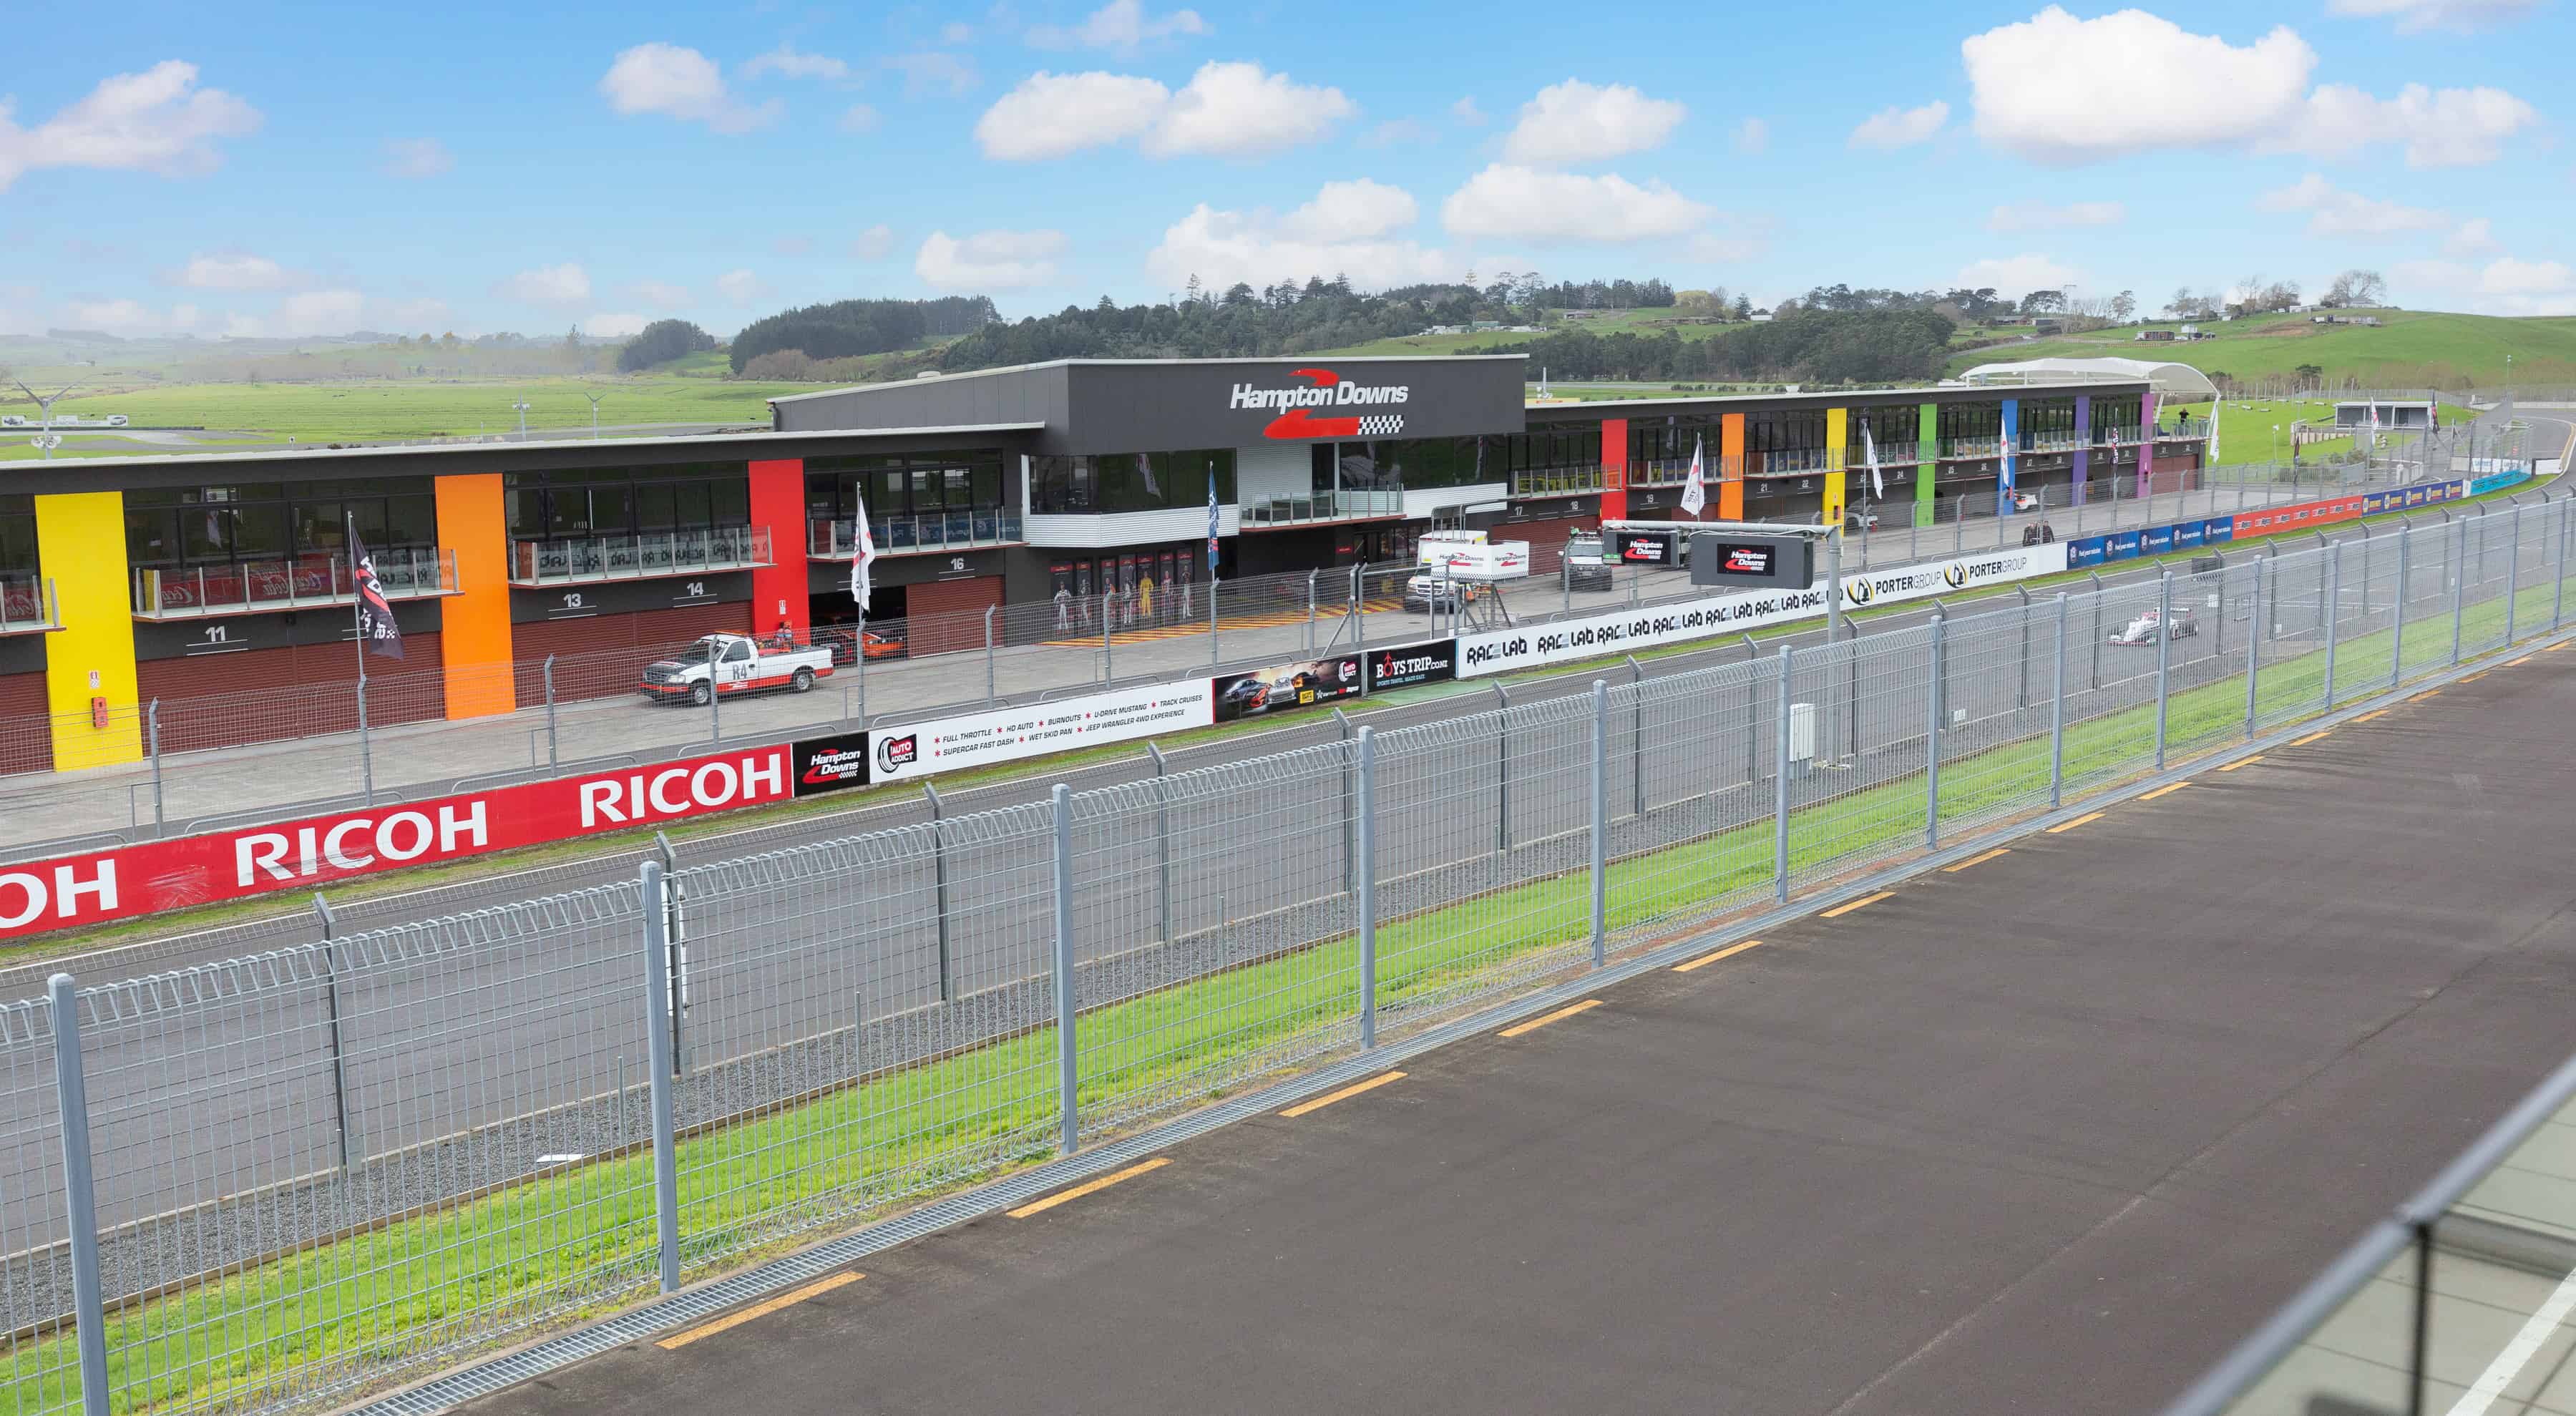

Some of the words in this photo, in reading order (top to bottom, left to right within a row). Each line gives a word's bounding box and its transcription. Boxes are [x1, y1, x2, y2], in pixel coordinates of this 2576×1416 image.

[1230, 383, 1333, 414] Hampton
[1336, 381, 1408, 405] Downs
[1760, 483, 1768, 492] 21
[1802, 479, 1809, 488] 22
[1570, 501, 1579, 510] 18
[1646, 494, 1654, 504] 19
[1515, 506, 1523, 516] 17
[1630, 540, 1663, 550] Hampton
[1636, 547, 1662, 555] Downs
[1731, 550, 1767, 561] Hampton
[1737, 558, 1765, 567] Downs
[950, 557, 965, 570] 16
[687, 582, 704, 596] 14
[563, 594, 581, 608] 13
[205, 625, 225, 642] 11
[732, 663, 747, 680] R4
[1376, 659, 1405, 678] BOYS
[943, 734, 958, 743] FULL
[960, 728, 992, 740] THROTTLE
[1017, 721, 1033, 731] AUTO
[1048, 714, 1081, 726] BURNOUTS
[1094, 708, 1117, 718] U-DRIVE
[1118, 703, 1147, 716] MUSTANG
[1160, 698, 1177, 708] TRACK
[1179, 695, 1202, 705] CRUISES
[943, 744, 978, 756] SUPERCAR
[980, 741, 995, 751] FAST
[997, 738, 1014, 748] DASH
[1044, 731, 1058, 739] SKID
[1059, 728, 1073, 736] PAN
[1085, 723, 1100, 732] JEEP
[1101, 718, 1135, 730] WRANGLER
[1136, 714, 1149, 723] 4WD
[1151, 709, 1185, 721] EXPERIENCE
[891, 741, 912, 756] AUTO
[811, 751, 861, 766] Hampton
[891, 752, 914, 763] ADDICT
[821, 761, 859, 775] Downs
[580, 753, 782, 829] RICOH
[235, 801, 488, 887] RICOH
